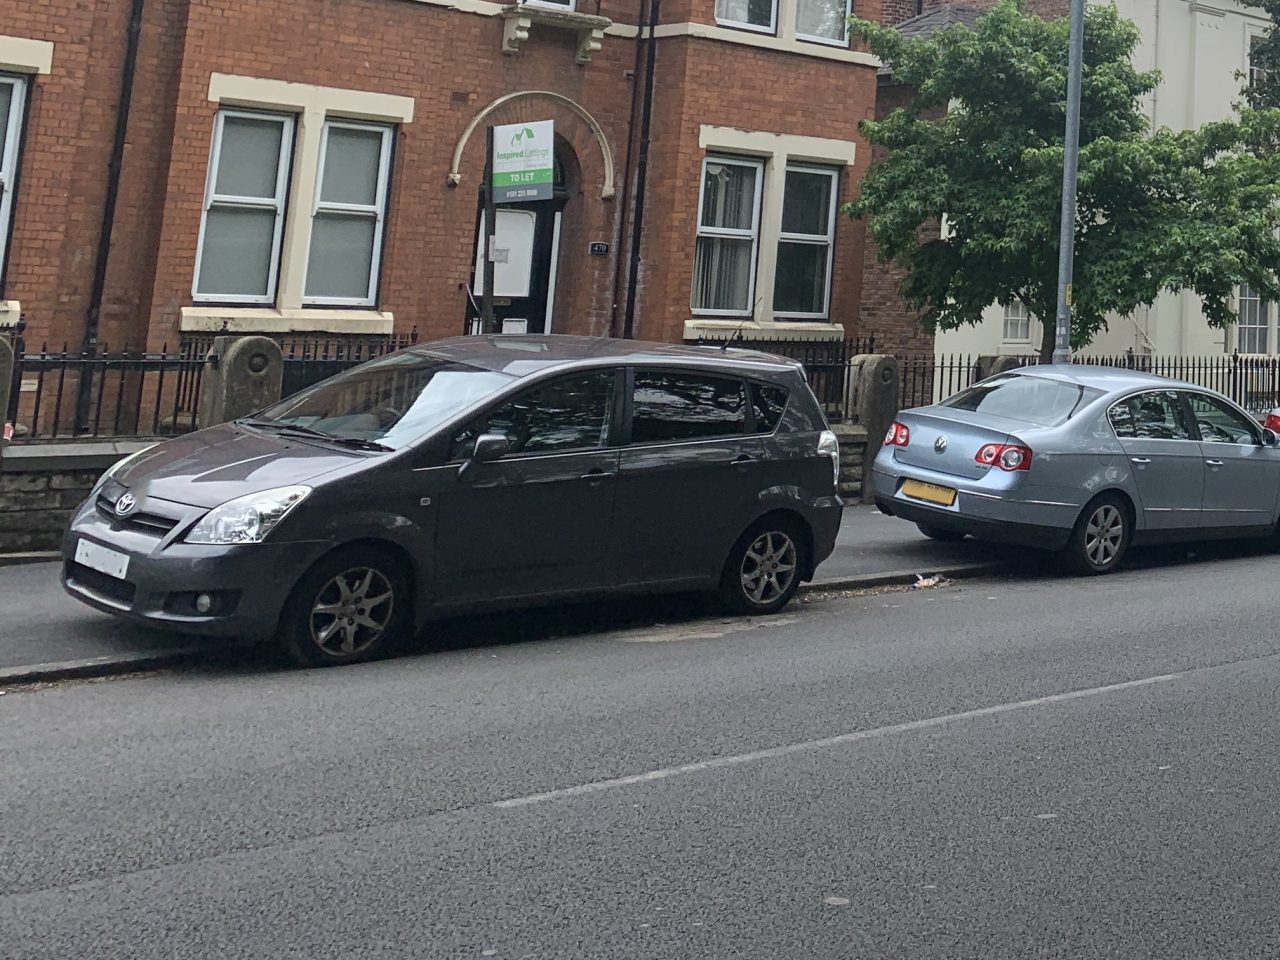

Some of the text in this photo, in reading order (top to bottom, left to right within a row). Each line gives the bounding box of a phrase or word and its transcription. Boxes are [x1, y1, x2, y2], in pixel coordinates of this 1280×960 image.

[497, 150, 524, 160] Inspired
[510, 172, 534, 182] TO LET
